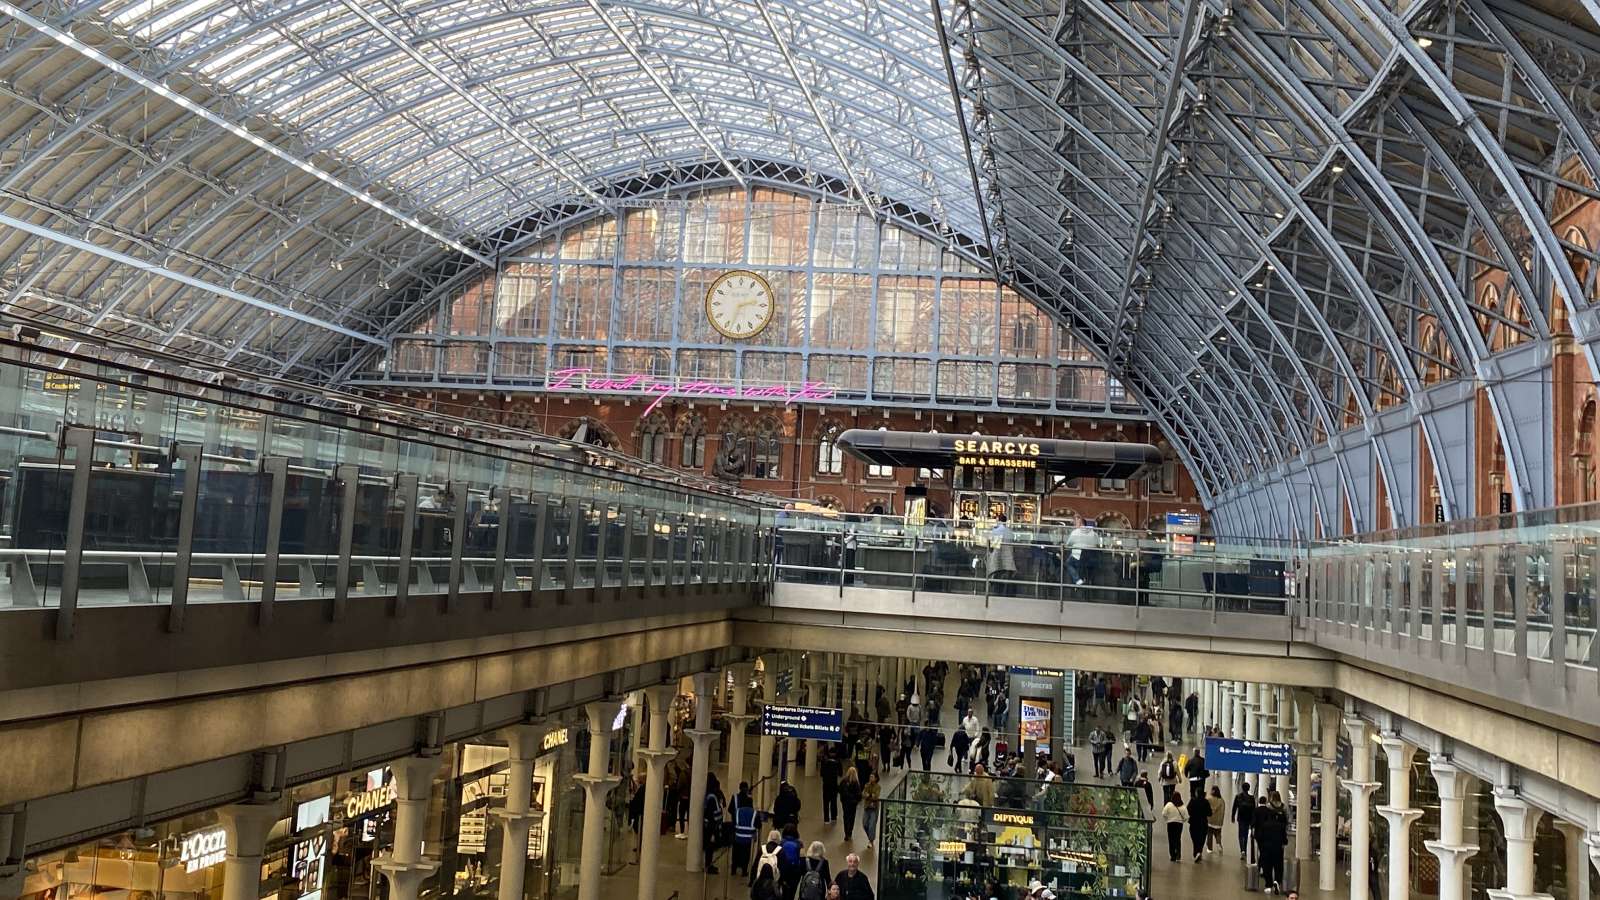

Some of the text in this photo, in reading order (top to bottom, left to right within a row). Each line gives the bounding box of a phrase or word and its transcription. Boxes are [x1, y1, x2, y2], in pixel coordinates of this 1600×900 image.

[547, 369, 591, 390] I
[954, 440, 1040, 456] SEARCYS
[959, 457, 1037, 469] BAR & BRASSERIE
[771, 705, 796, 713] Departures
[771, 721, 799, 729] International
[543, 728, 568, 750] CHANEL
[347, 786, 393, 818] CHANEL
[993, 813, 1034, 825] DIPTYQUE
